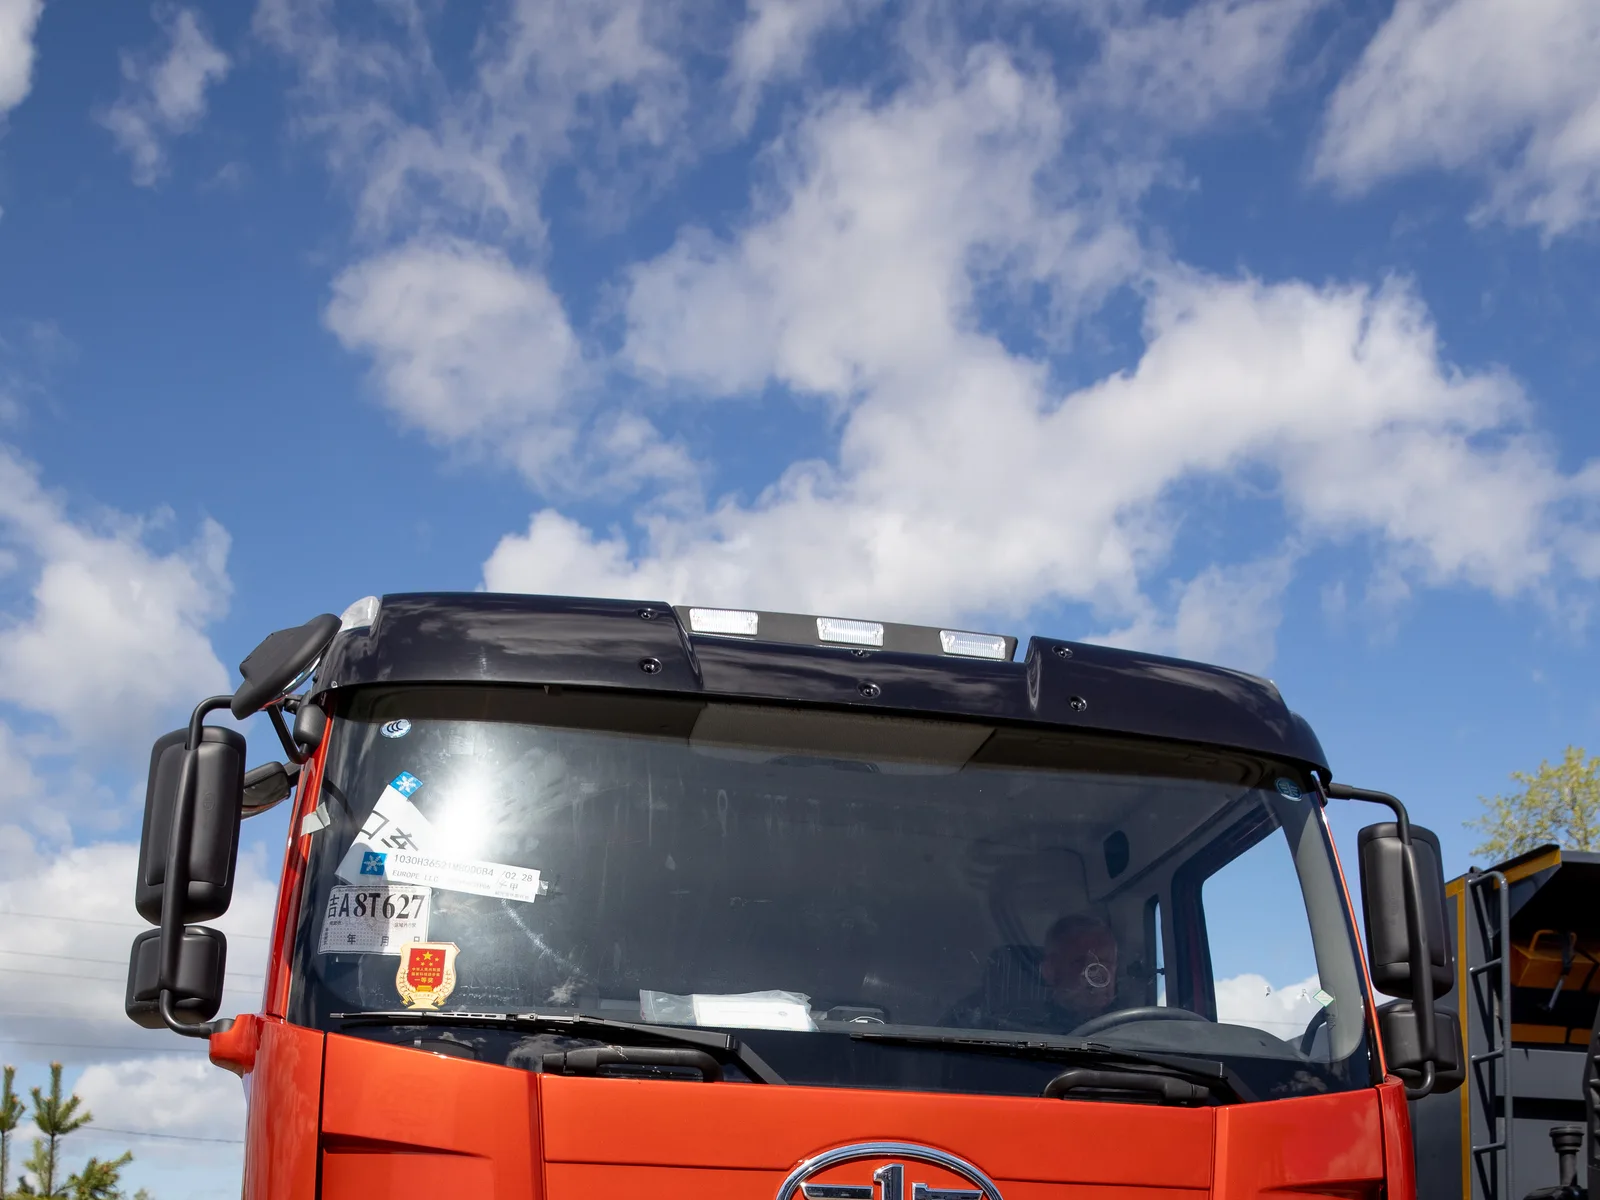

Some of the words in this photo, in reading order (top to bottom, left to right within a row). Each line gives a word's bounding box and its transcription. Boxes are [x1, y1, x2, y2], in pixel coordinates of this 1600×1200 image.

[392, 869, 419, 880] EUROPE
[347, 933, 357, 945] 年
[380, 935, 389, 947] 月
